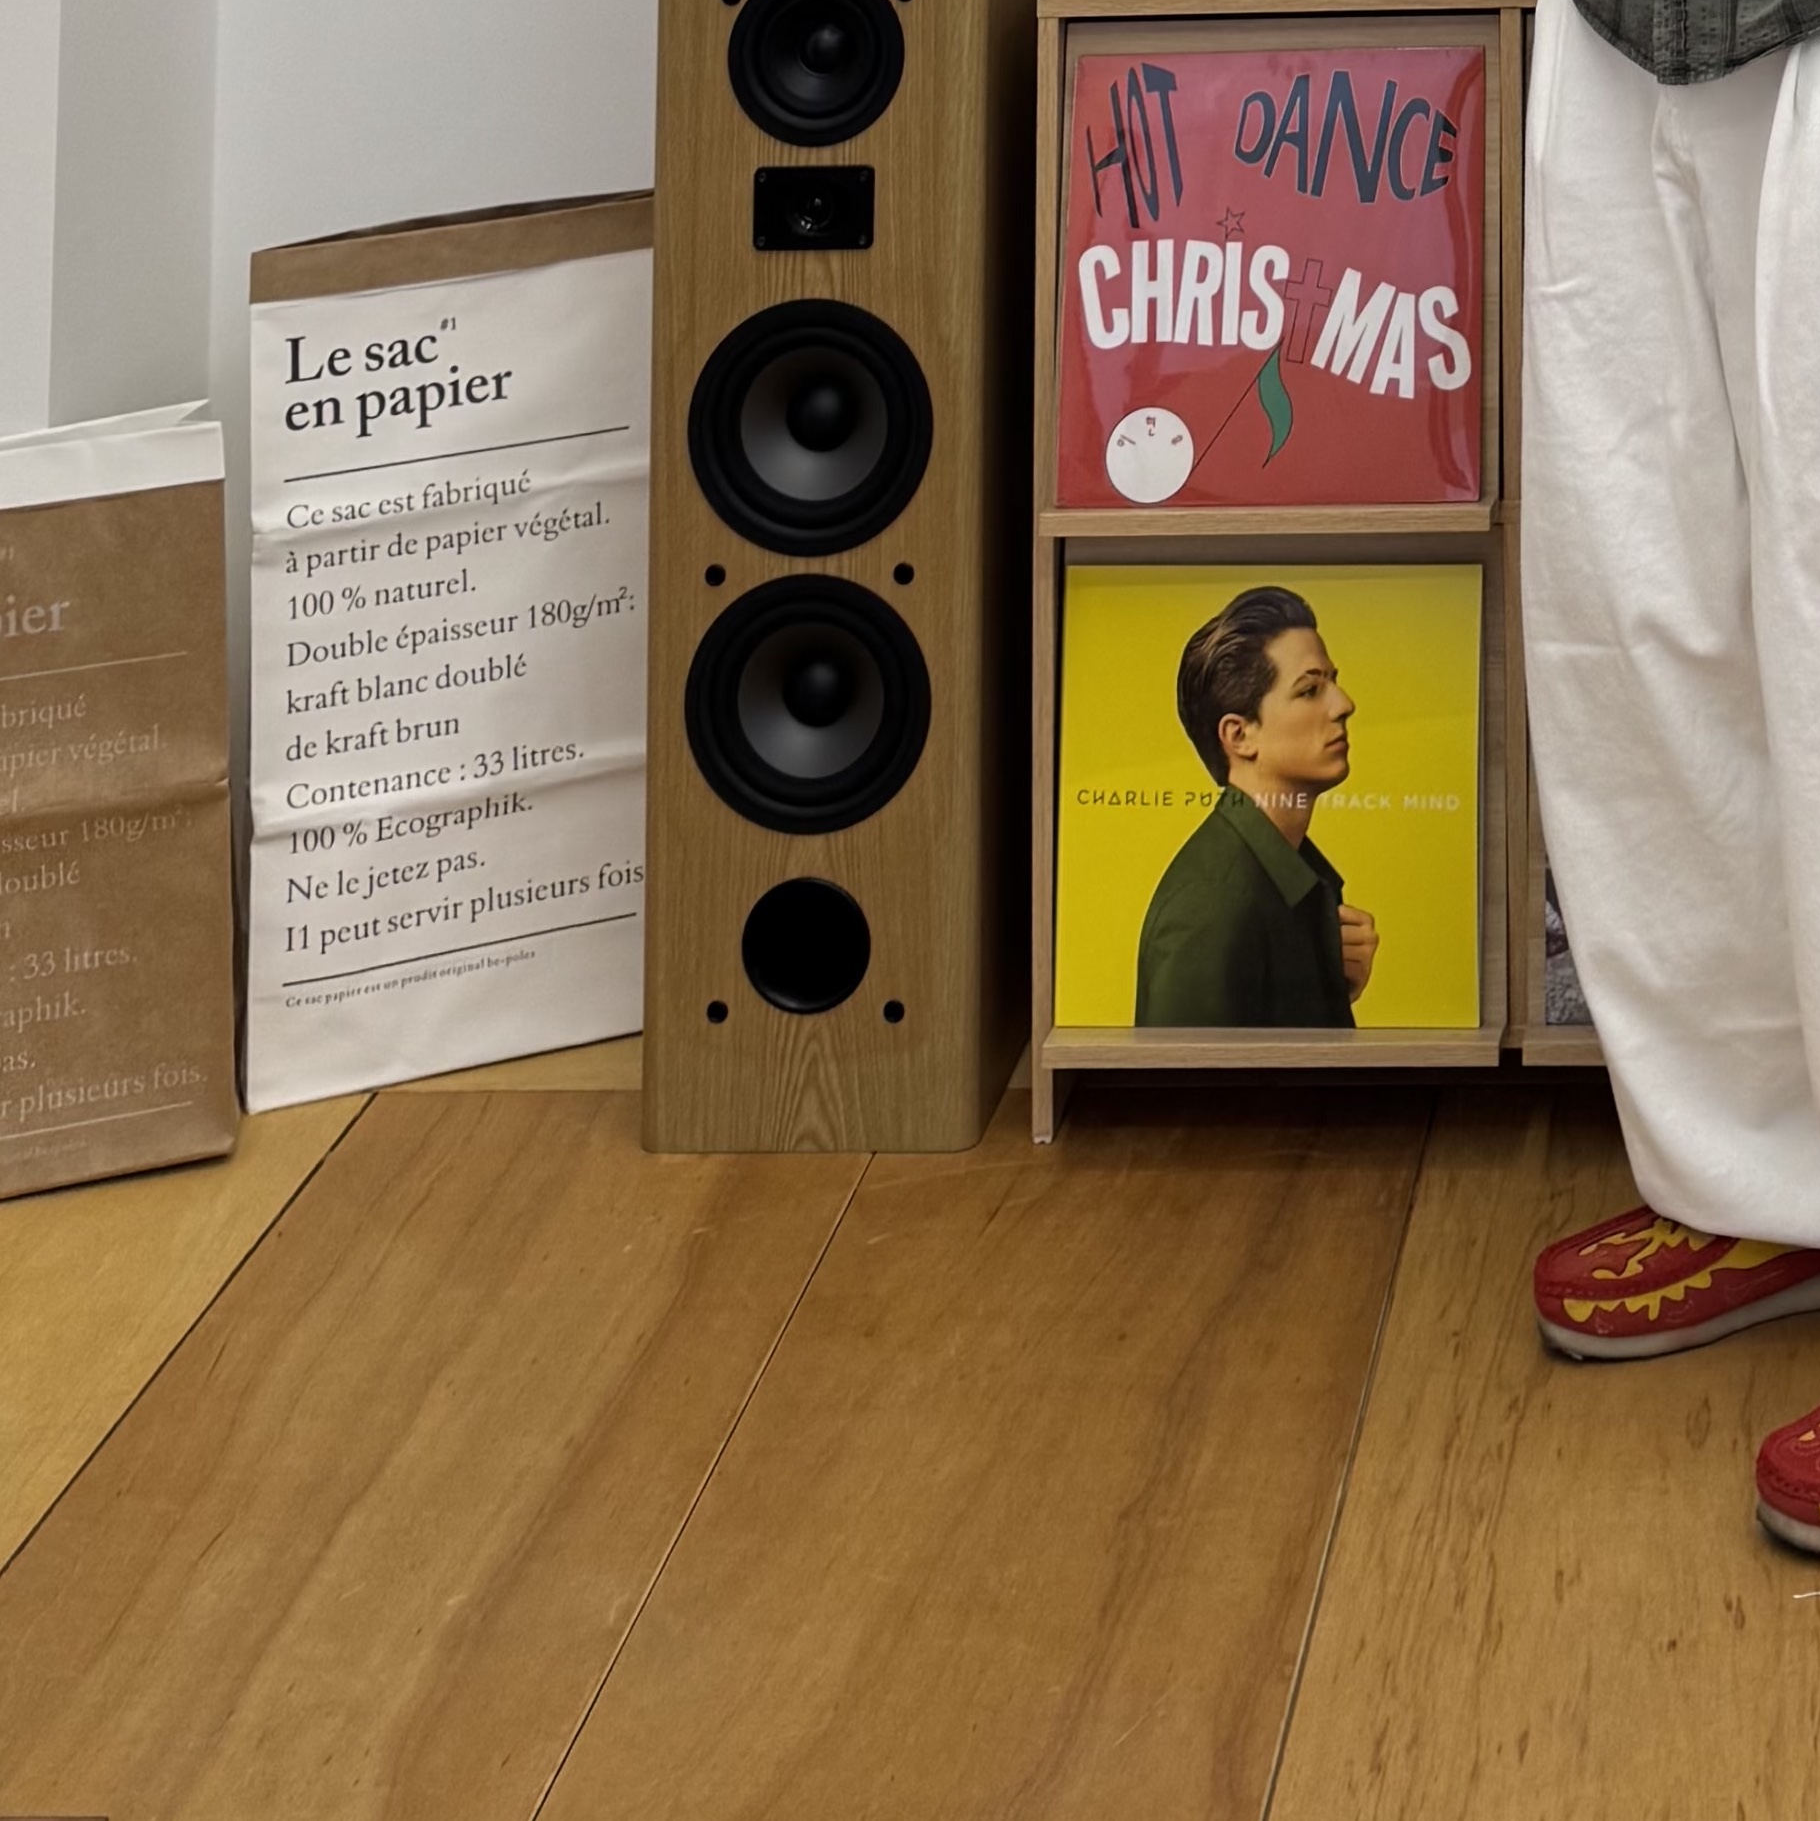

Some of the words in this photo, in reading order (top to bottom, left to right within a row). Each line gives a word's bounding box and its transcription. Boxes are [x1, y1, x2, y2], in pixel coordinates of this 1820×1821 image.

[1086, 62, 1184, 229] HOT
[1234, 69, 1458, 205] DANCE
[285, 335, 352, 385] Le
[364, 333, 440, 372] sac
[284, 396, 345, 432] en
[356, 365, 513, 439] papier
[286, 503, 324, 530] Ce
[331, 498, 371, 523] sac
[378, 493, 416, 517] est
[422, 469, 532, 510] fabriqué
[285, 551, 299, 574] à
[306, 535, 381, 578] partir
[387, 530, 418, 557] de
[425, 519, 508, 561] papier
[514, 501, 611, 542] végétal.
[0, 594, 70, 638] ier
[287, 589, 335, 621] 100
[342, 587, 367, 612] %
[374, 569, 477, 607] naturel.
[286, 628, 388, 667] Double
[395, 611, 520, 655] épaisseur
[286, 681, 350, 715] kraft
[357, 668, 429, 704] blanc
[434, 652, 528, 691] doublé
[285, 734, 318, 762] de
[326, 721, 390, 756] kraft
[395, 715, 460, 745] brun
[286, 764, 452, 810] Contenance
[473, 751, 505, 780] 33
[512, 741, 585, 772] litres.
[1077, 788, 1174, 807] CHARLIE
[1254, 791, 1308, 809] NINE
[1320, 792, 1392, 810] TRACK
[1402, 793, 1461, 811] MIND
[289, 824, 335, 855] 100
[342, 821, 368, 847] %
[376, 791, 534, 843] Ecographik.
[0, 859, 81, 895] oublé
[286, 876, 329, 904] Ne
[337, 869, 360, 897] le
[362, 858, 430, 900] jetez
[436, 849, 487, 886] pas.
[320, 918, 382, 955] peut
[386, 897, 465, 934] servir
[469, 872, 591, 923] plusieurs
[598, 860, 645, 890] fois
[0, 991, 86, 1034] aphik.
